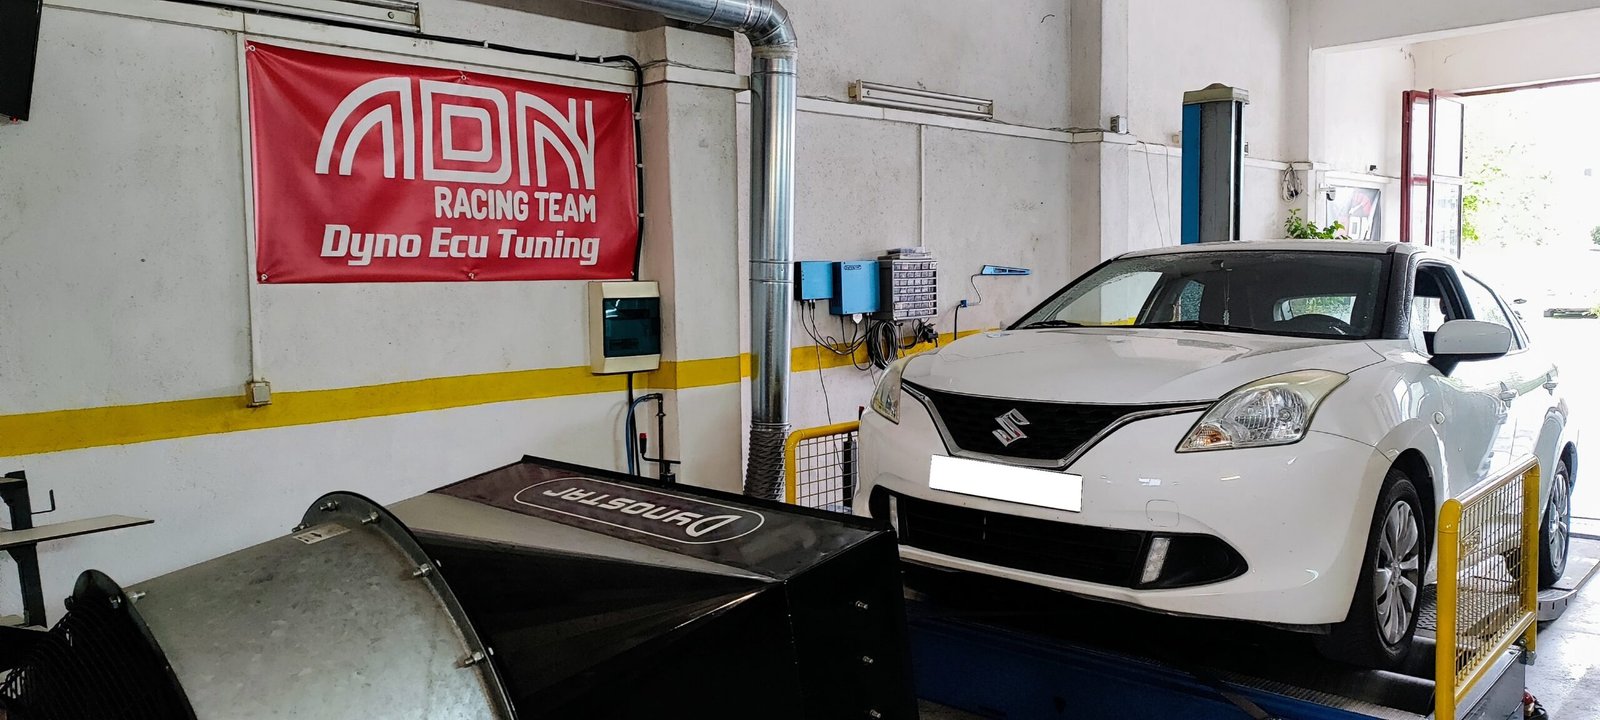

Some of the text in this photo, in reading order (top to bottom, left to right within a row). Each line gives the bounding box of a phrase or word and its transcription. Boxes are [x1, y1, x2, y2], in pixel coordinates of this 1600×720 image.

[315, 77, 595, 189] ADN
[434, 186, 596, 223] RACING TEAM
[320, 224, 600, 266] Dyno Ecu Tuning
